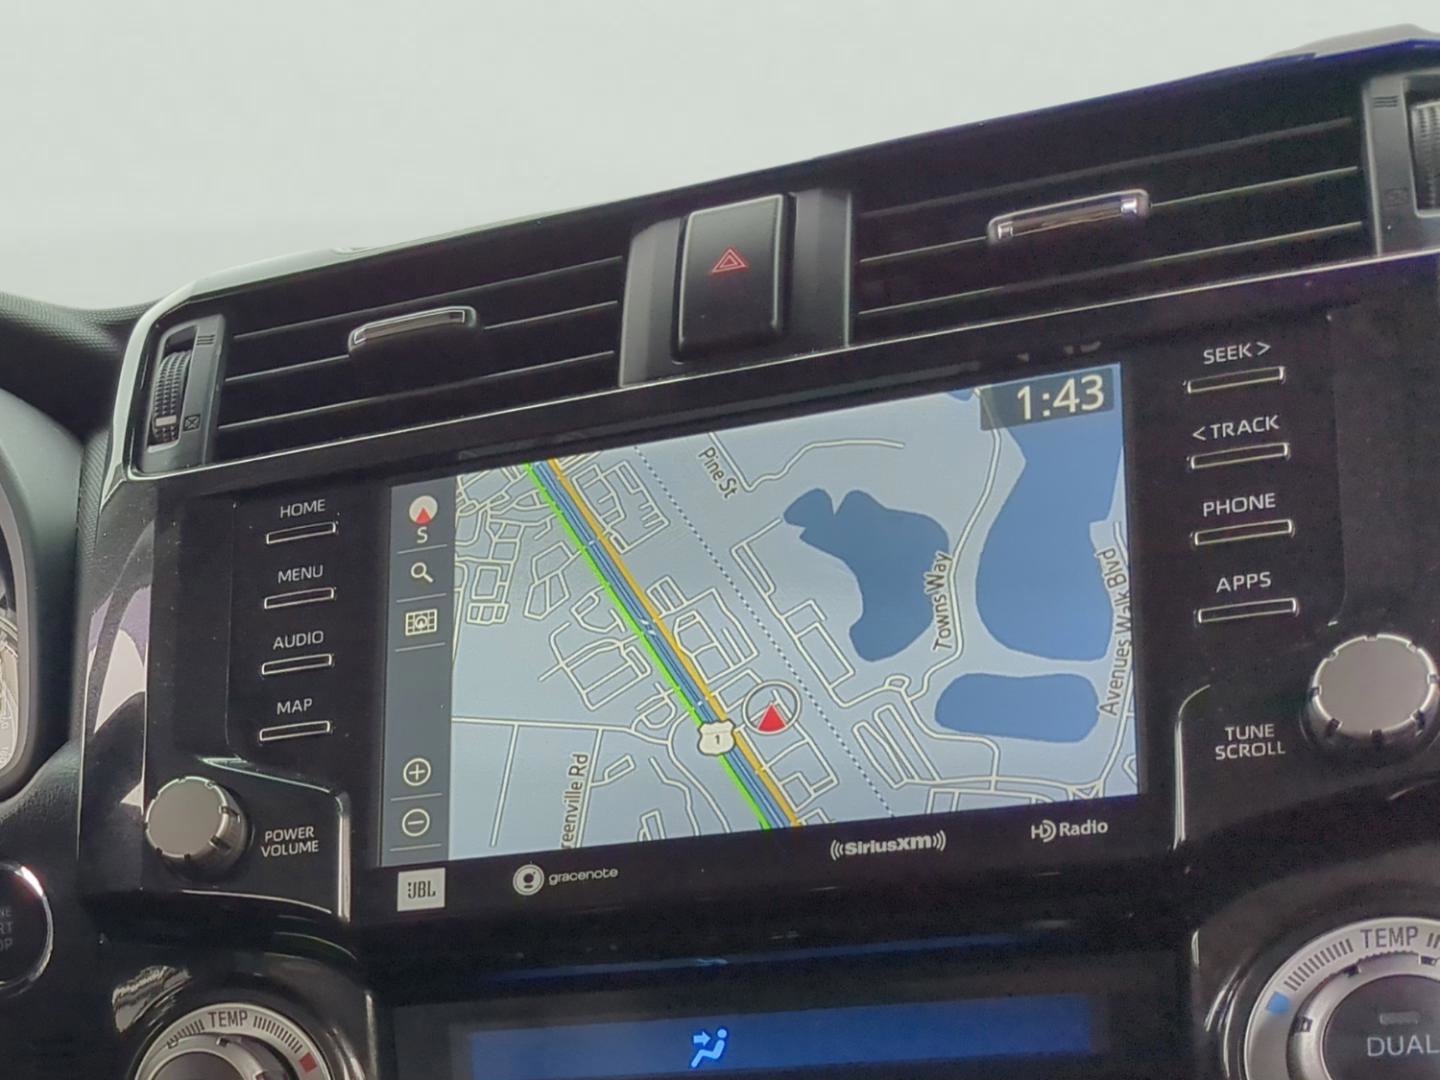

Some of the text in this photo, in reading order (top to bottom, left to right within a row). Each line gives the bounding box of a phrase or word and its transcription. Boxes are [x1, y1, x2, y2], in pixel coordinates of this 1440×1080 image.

[1203, 342, 1253, 365] SEEK
[1017, 374, 1105, 420] 1:43
[1210, 415, 1280, 439] TRACK
[698, 446, 737, 498] Pine St
[280, 499, 326, 518] HOME
[1202, 493, 1277, 517] PHONE
[417, 526, 428, 544] S
[278, 564, 324, 584] MENU
[1096, 547, 1127, 589] Blvd
[1216, 571, 1272, 593] APPS
[926, 552, 954, 650] Towns Way
[273, 630, 324, 650] AUDIO
[1099, 639, 1132, 715] Avenues
[276, 698, 313, 715] MAP
[715, 734, 720, 744] 1
[1224, 723, 1275, 741] TUNE
[1215, 741, 1287, 760] SCROLL
[569, 753, 589, 777] Rd
[264, 826, 315, 843] POWER
[1059, 820, 1108, 837] Radio
[261, 840, 320, 858] VOLUME
[548, 868, 619, 886] gracenote
[407, 880, 436, 899] JBL
[1360, 926, 1418, 949] TEMP
[208, 1010, 248, 1028] TEMP
[1367, 1034, 1440, 1056] DUAL
